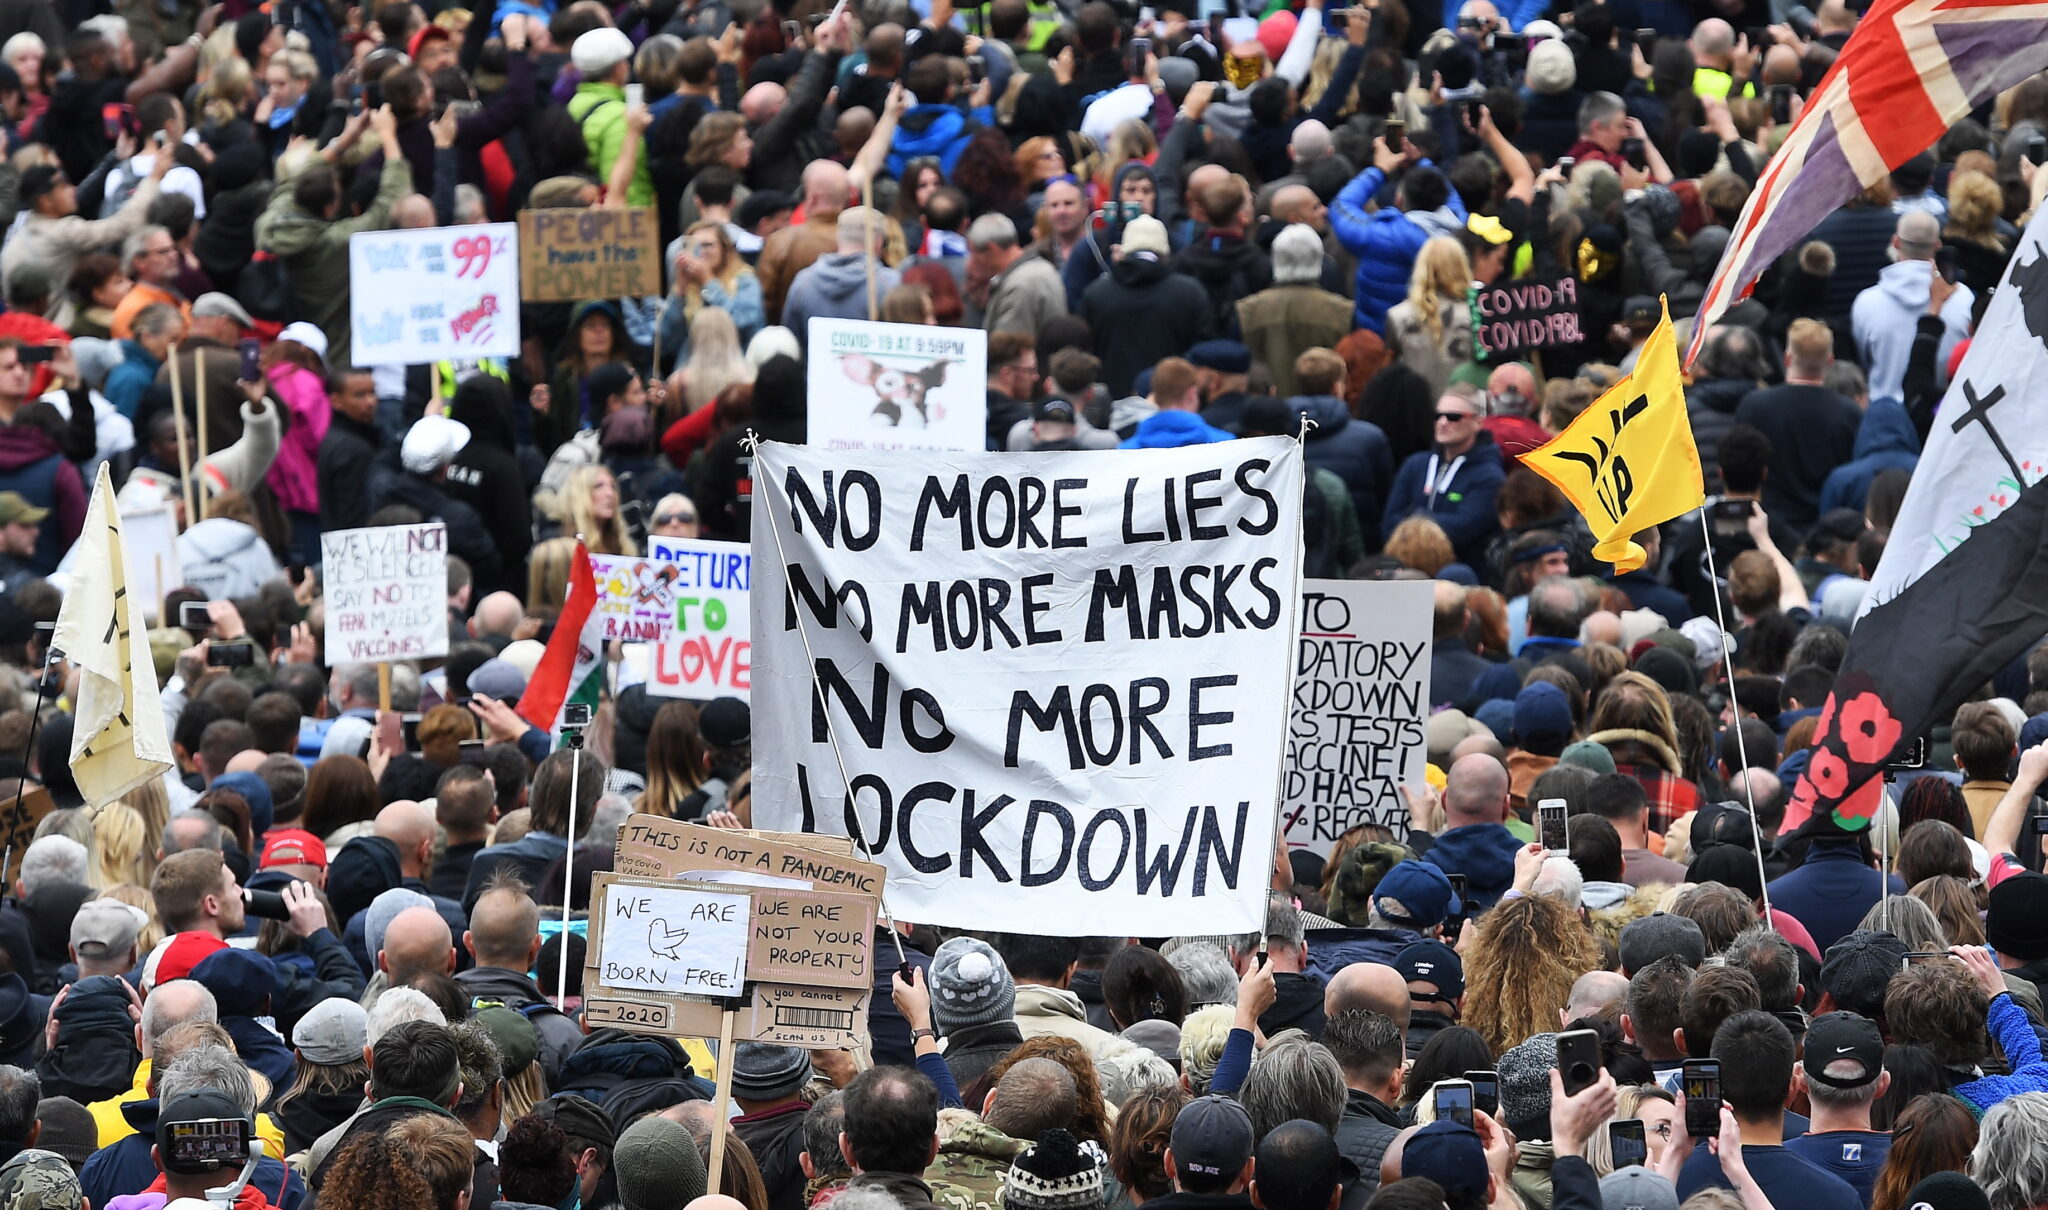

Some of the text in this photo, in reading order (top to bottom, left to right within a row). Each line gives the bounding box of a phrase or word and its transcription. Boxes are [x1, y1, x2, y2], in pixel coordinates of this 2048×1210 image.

[535, 211, 646, 246] PEOPLE
[547, 243, 637, 265] have the
[532, 265, 645, 298] POWER
[1477, 277, 1577, 317] COVID-19
[785, 459, 1279, 551] NO MORE LIES
[323, 533, 360, 559] WE
[407, 527, 446, 555] NOT
[333, 583, 432, 610] SAY NO TO
[785, 557, 1281, 653] NO MORE MASKS
[339, 612, 367, 632] FEAR
[677, 597, 727, 631] TO
[348, 635, 425, 659] VACCINES
[657, 636, 751, 689] LOVE
[812, 657, 1238, 770] NO MORE
[1313, 771, 1374, 807] HAS
[1376, 778, 1400, 807] A
[631, 826, 681, 851] THIS
[756, 852, 772, 870] A
[780, 855, 877, 893] PANDEMIC
[615, 897, 737, 923] WE ARE
[758, 901, 843, 922] WE ARE
[756, 926, 867, 949] NOT YOUR
[606, 956, 739, 990] BORN FREE!
[774, 988, 843, 1002] you cannot
[617, 1006, 663, 1023] 2020
